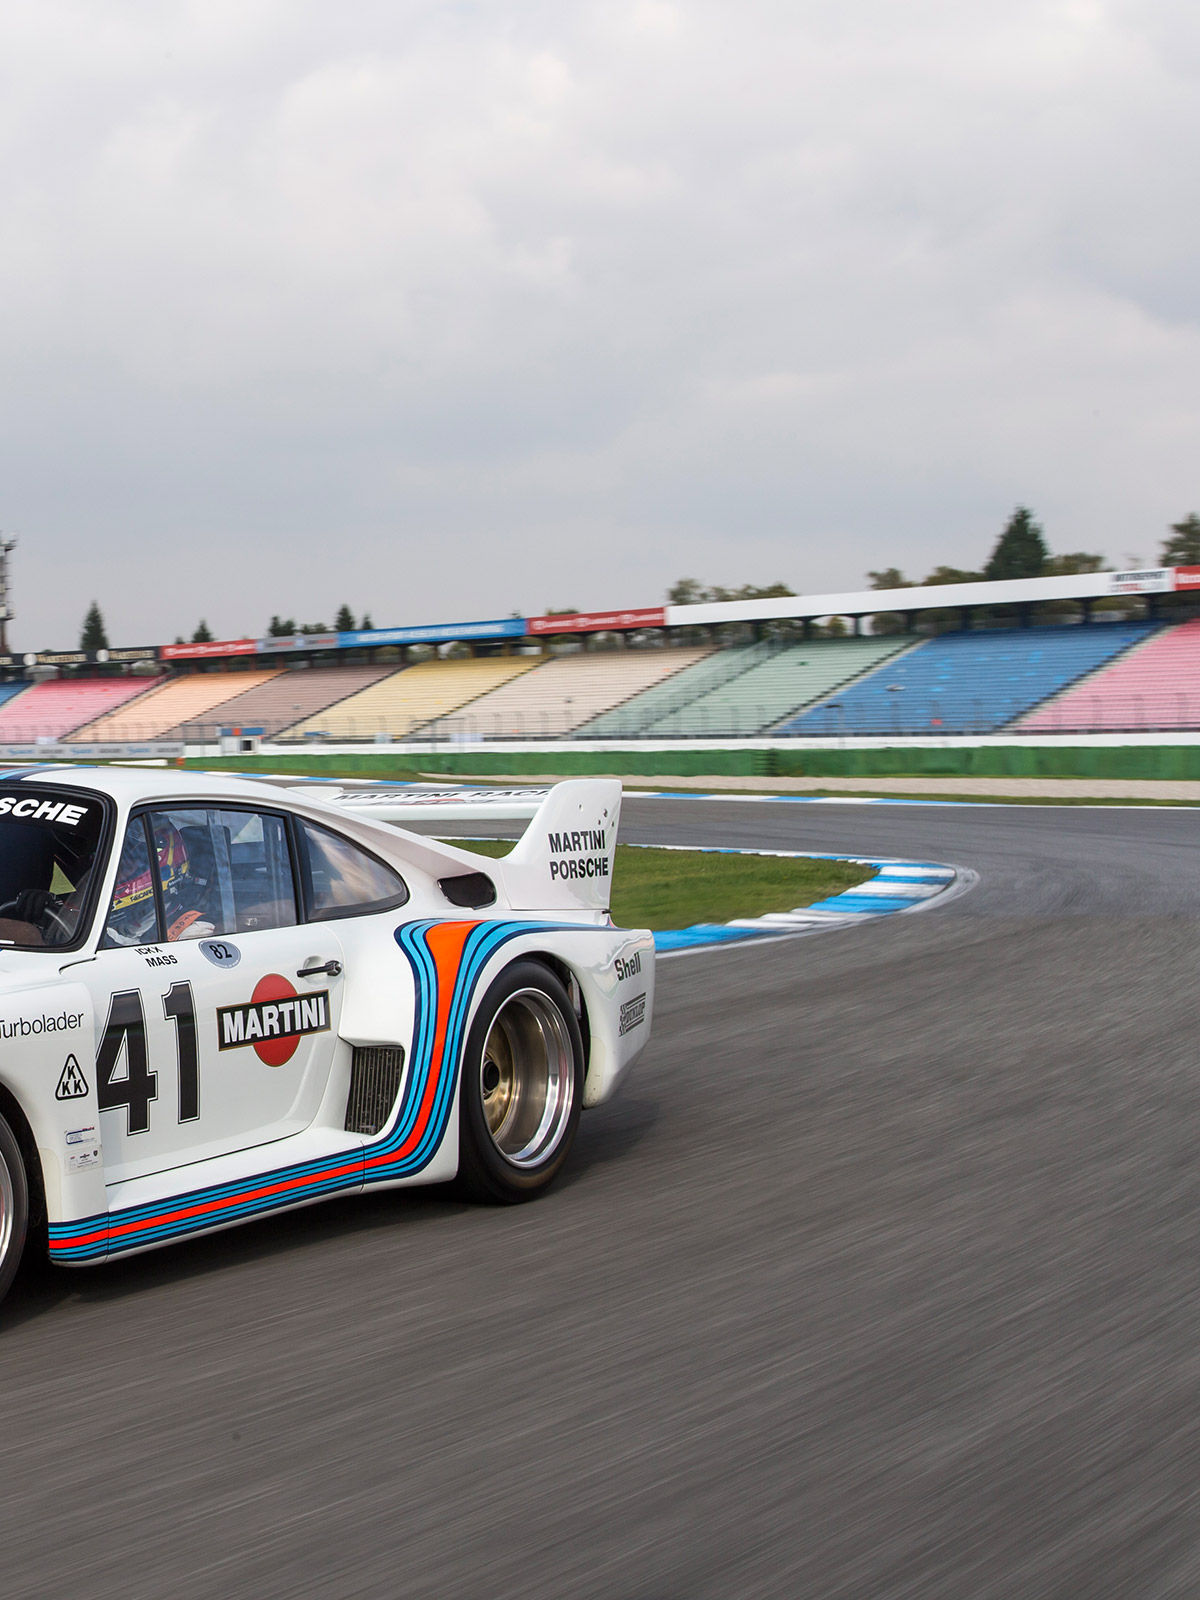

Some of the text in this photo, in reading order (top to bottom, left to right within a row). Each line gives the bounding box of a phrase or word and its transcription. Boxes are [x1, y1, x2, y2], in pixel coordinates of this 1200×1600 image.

[332, 792, 462, 801] MARTINI
[469, 790, 550, 798] RACI
[548, 830, 606, 853] MARTINI
[549, 857, 609, 880] PORSCHE
[145, 954, 178, 968] MASS
[209, 943, 233, 960] 82
[614, 951, 642, 981] Shell
[222, 996, 327, 1044] MARTINI
[95, 980, 201, 1137] 41
